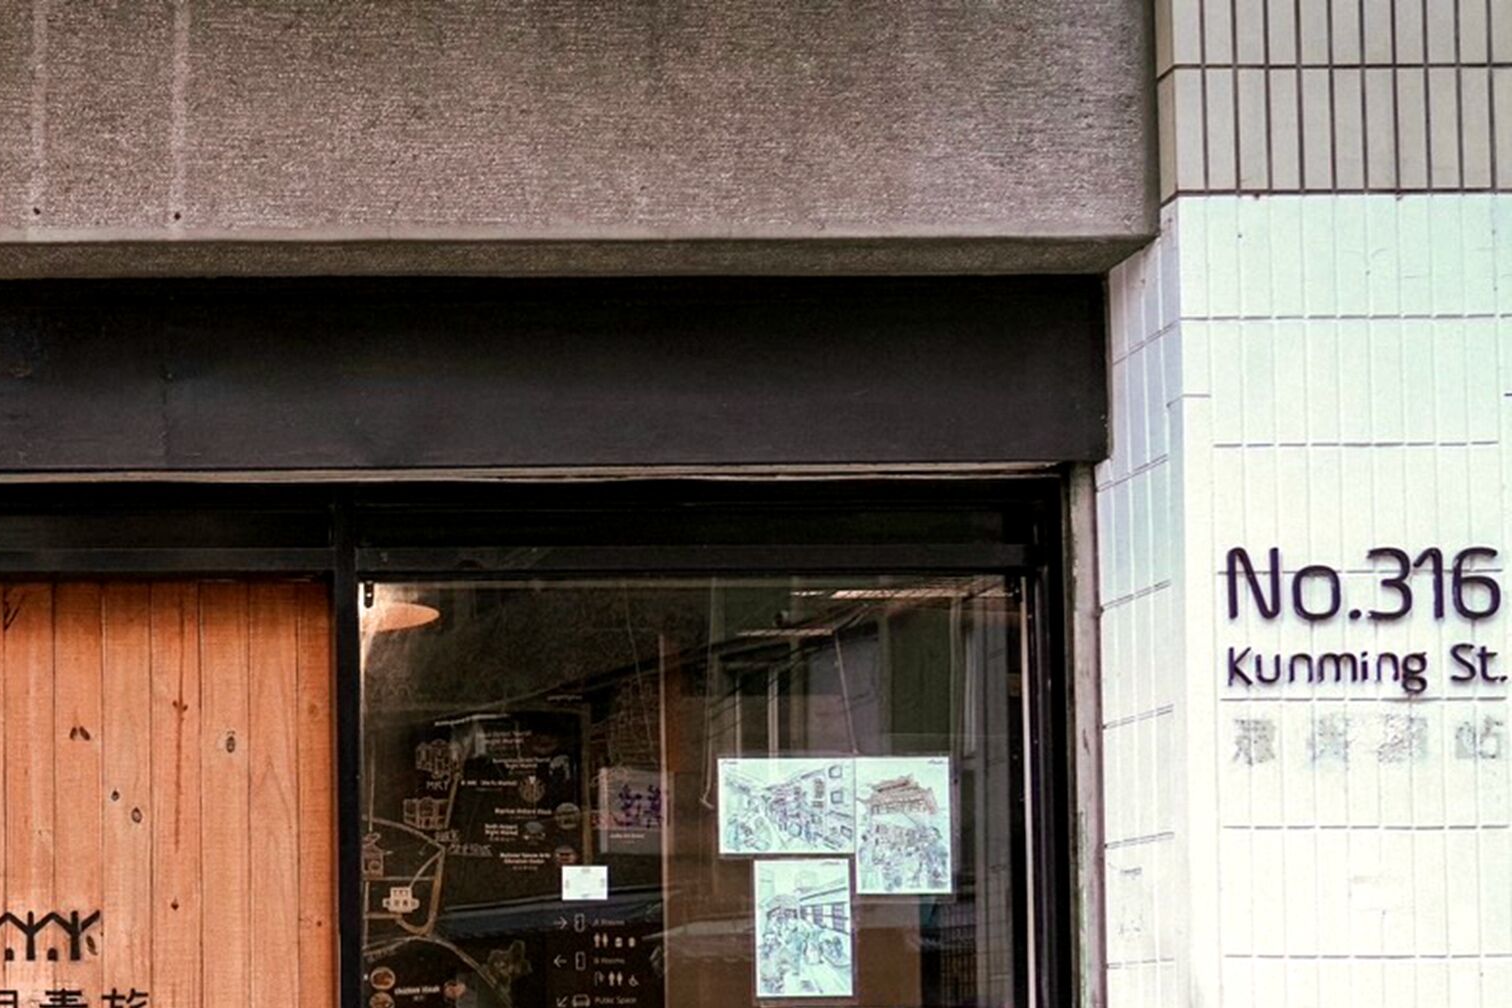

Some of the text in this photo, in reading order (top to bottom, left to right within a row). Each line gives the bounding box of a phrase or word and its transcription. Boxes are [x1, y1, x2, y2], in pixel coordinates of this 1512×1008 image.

[1226, 546, 1502, 622] No.316
[1227, 642, 1509, 695] Kunming St.
